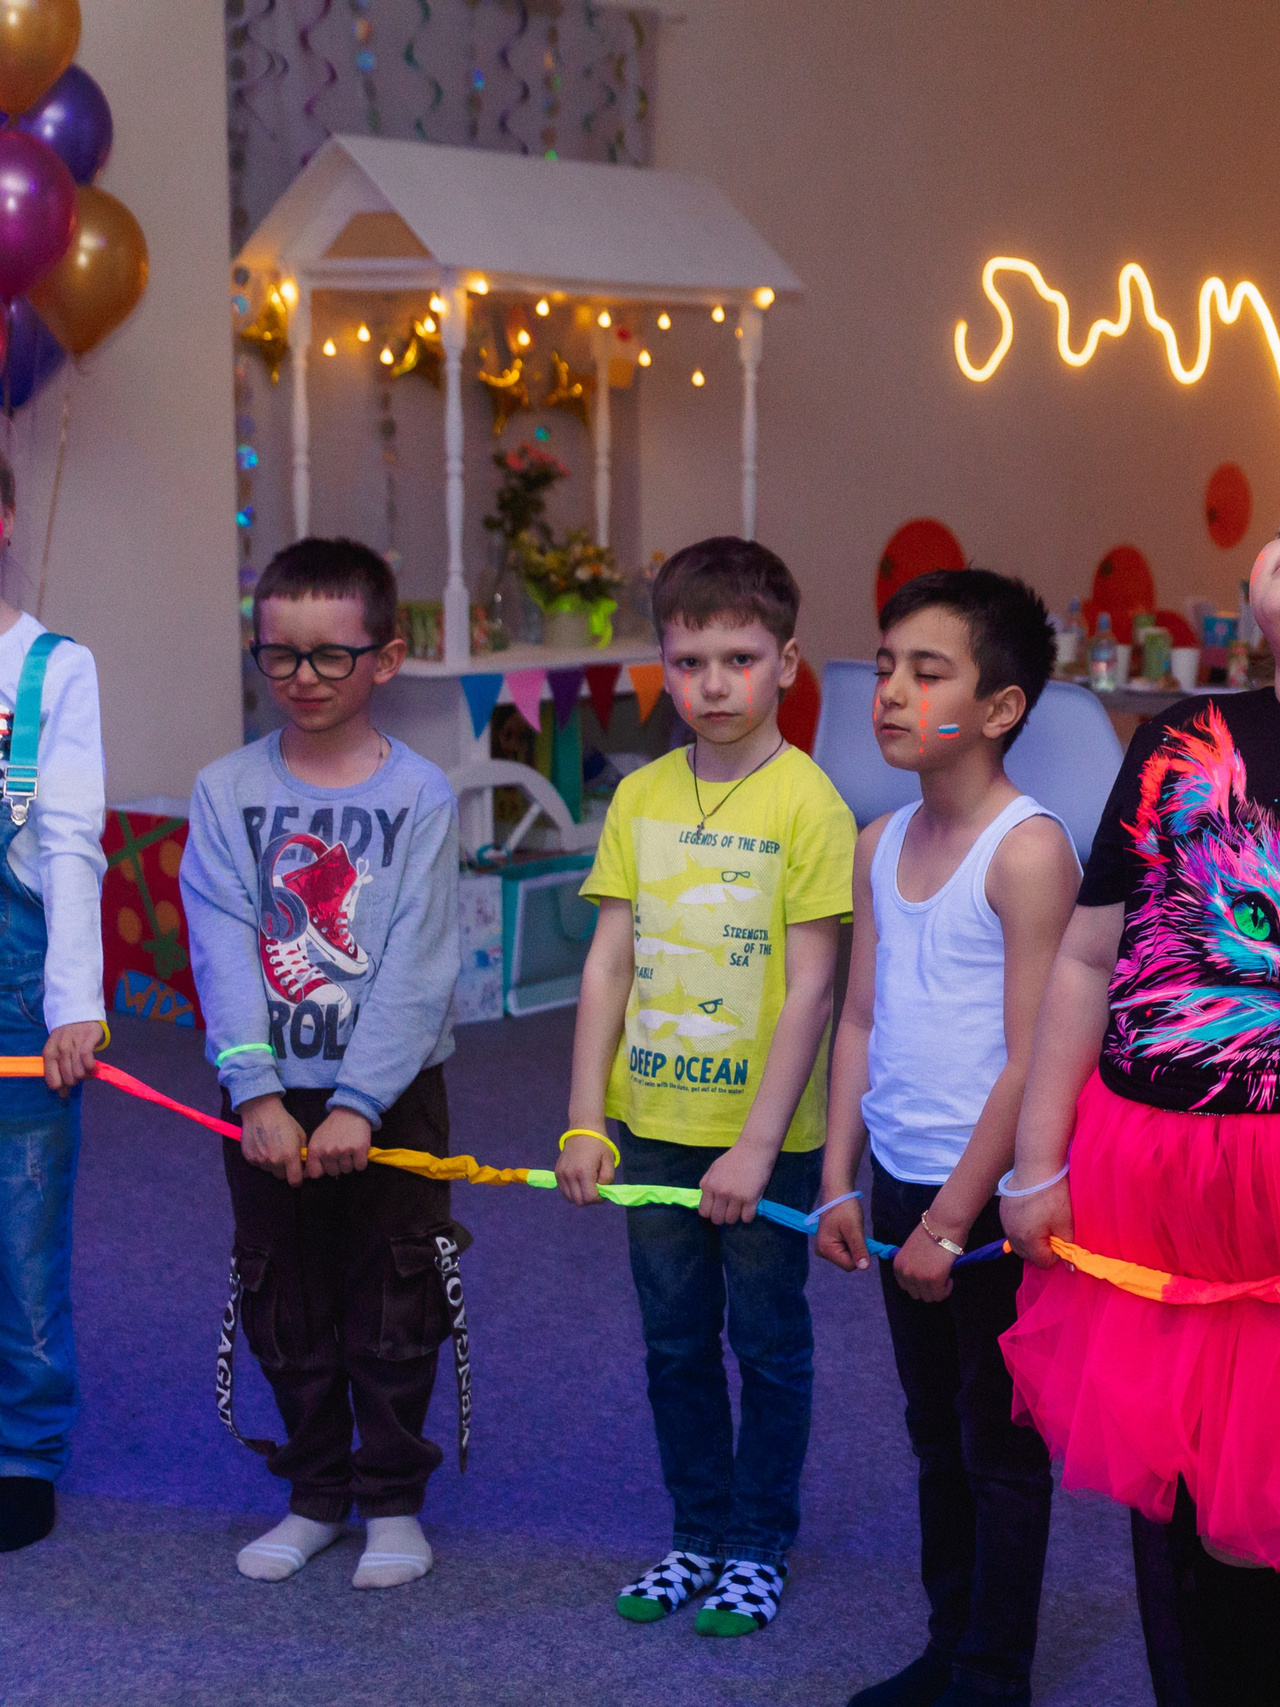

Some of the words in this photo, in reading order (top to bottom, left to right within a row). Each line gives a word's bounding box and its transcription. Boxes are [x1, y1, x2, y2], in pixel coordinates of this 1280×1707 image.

[243, 805, 410, 869] READY
[679, 830, 719, 847] LEGENDS
[720, 834, 735, 848] OF
[738, 836, 757, 852] THE
[758, 839, 781, 855] DEEP
[722, 924, 769, 941] STRENGTH
[729, 952, 749, 967] SEA
[743, 942, 756, 954] OF
[759, 943, 772, 955] THE
[268, 1000, 360, 1061] ROL
[629, 1045, 668, 1078] DEEP
[674, 1054, 749, 1086] OCEAN
